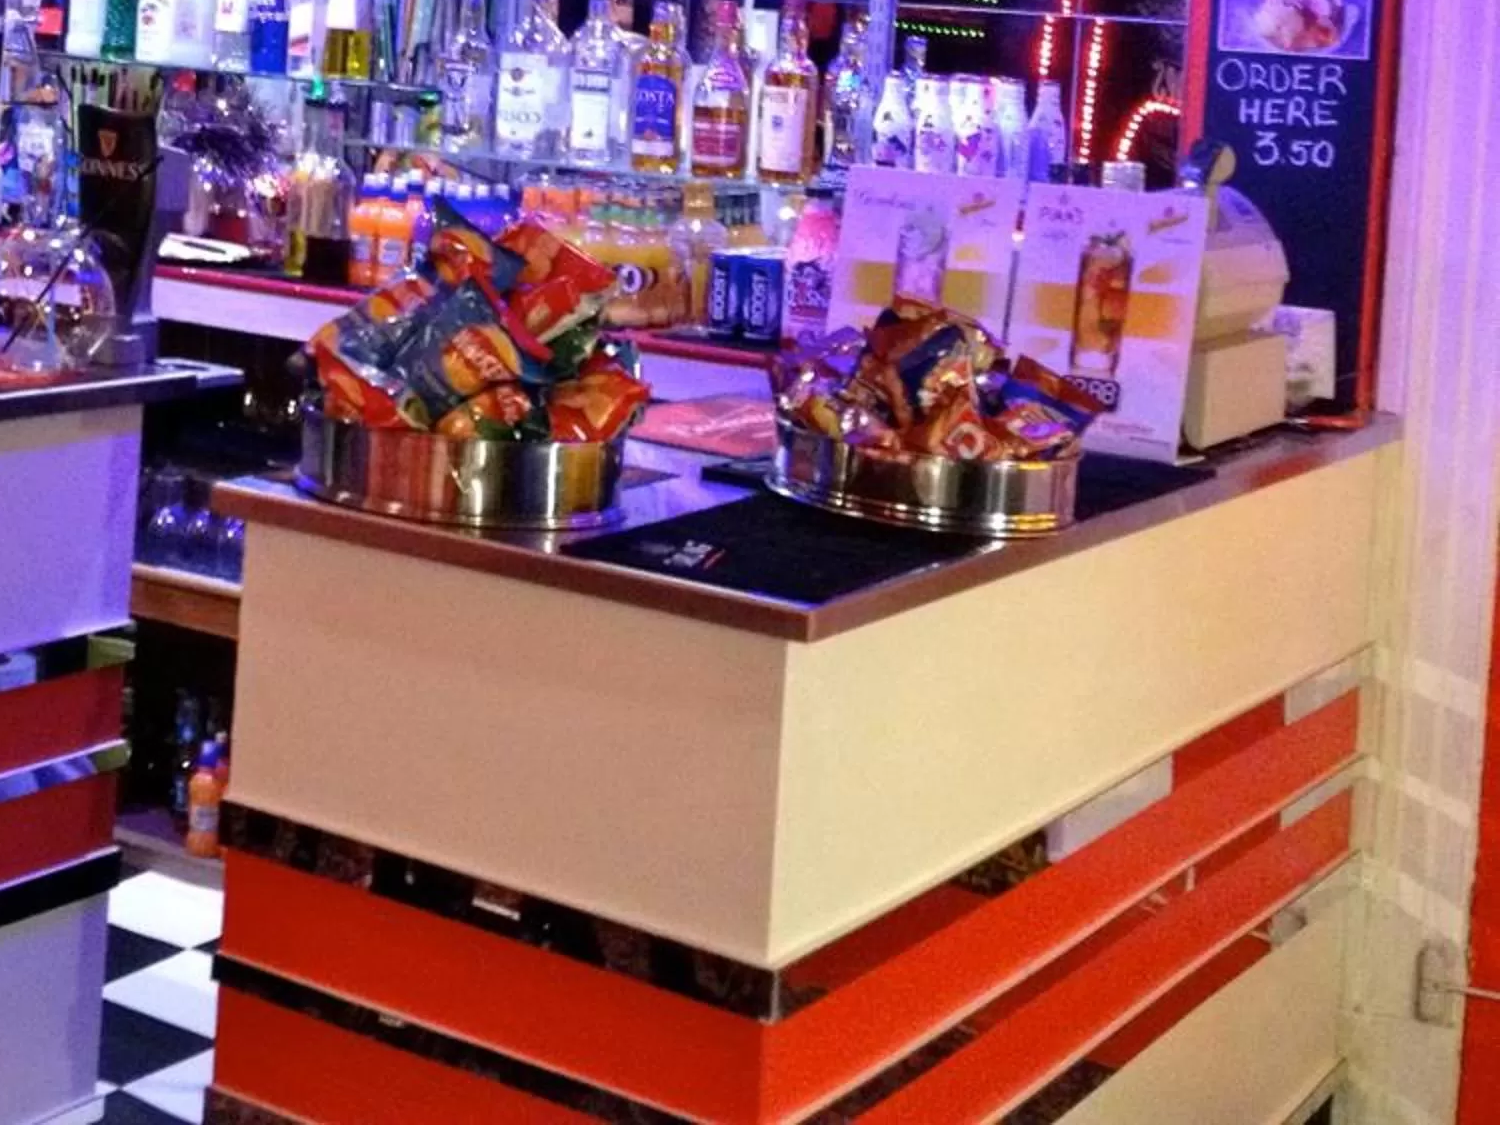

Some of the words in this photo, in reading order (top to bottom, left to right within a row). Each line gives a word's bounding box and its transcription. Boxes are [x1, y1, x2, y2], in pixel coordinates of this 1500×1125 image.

[1216, 57, 1347, 96] ORDER
[1239, 98, 1339, 129] HERE
[1252, 130, 1335, 169] 3.50
